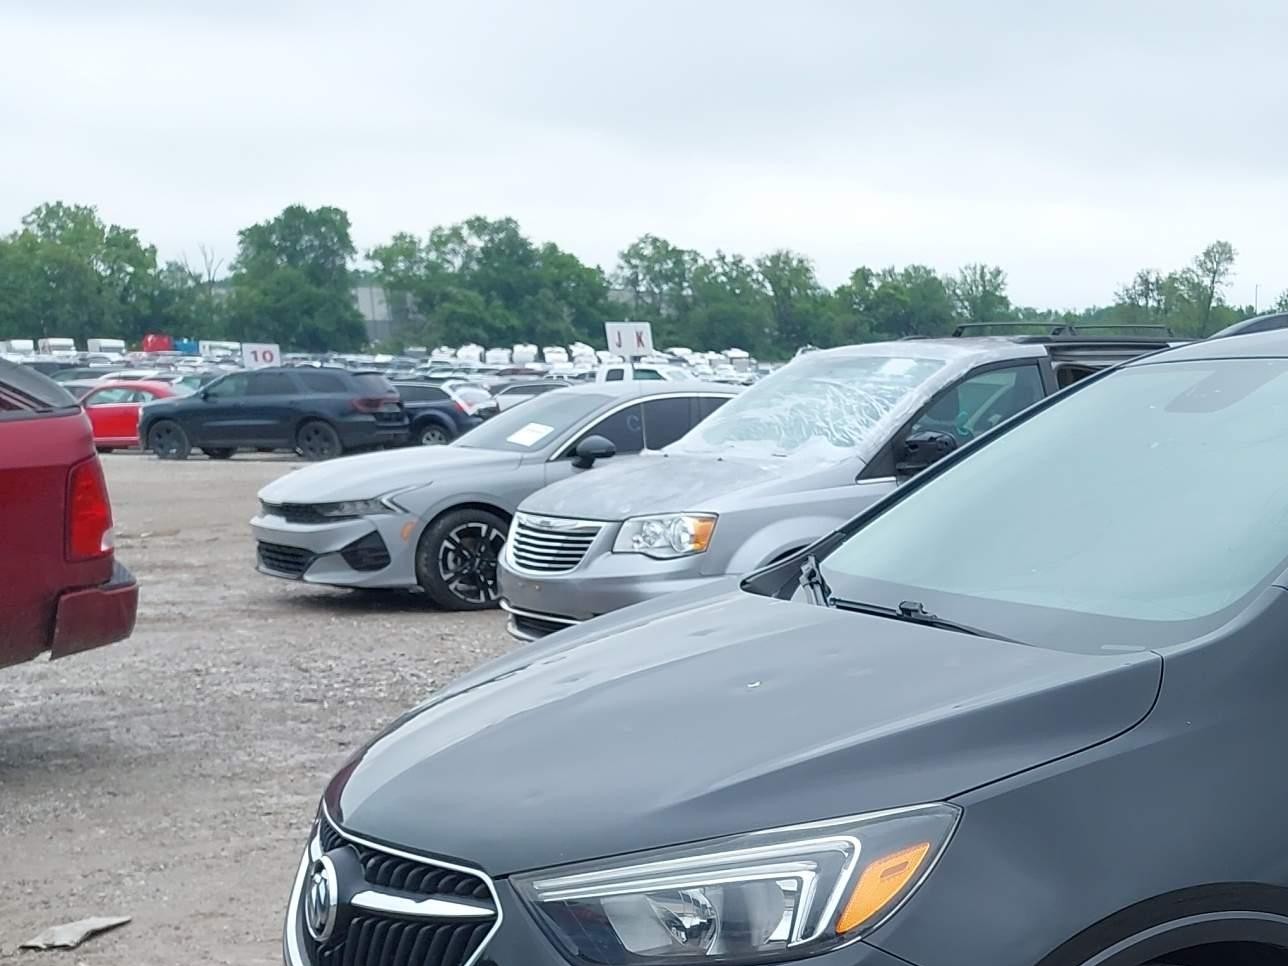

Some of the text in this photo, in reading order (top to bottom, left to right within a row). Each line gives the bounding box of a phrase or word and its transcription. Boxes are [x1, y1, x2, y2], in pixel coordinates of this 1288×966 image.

[616, 331, 645, 348] J K
[250, 350, 274, 363] 10
